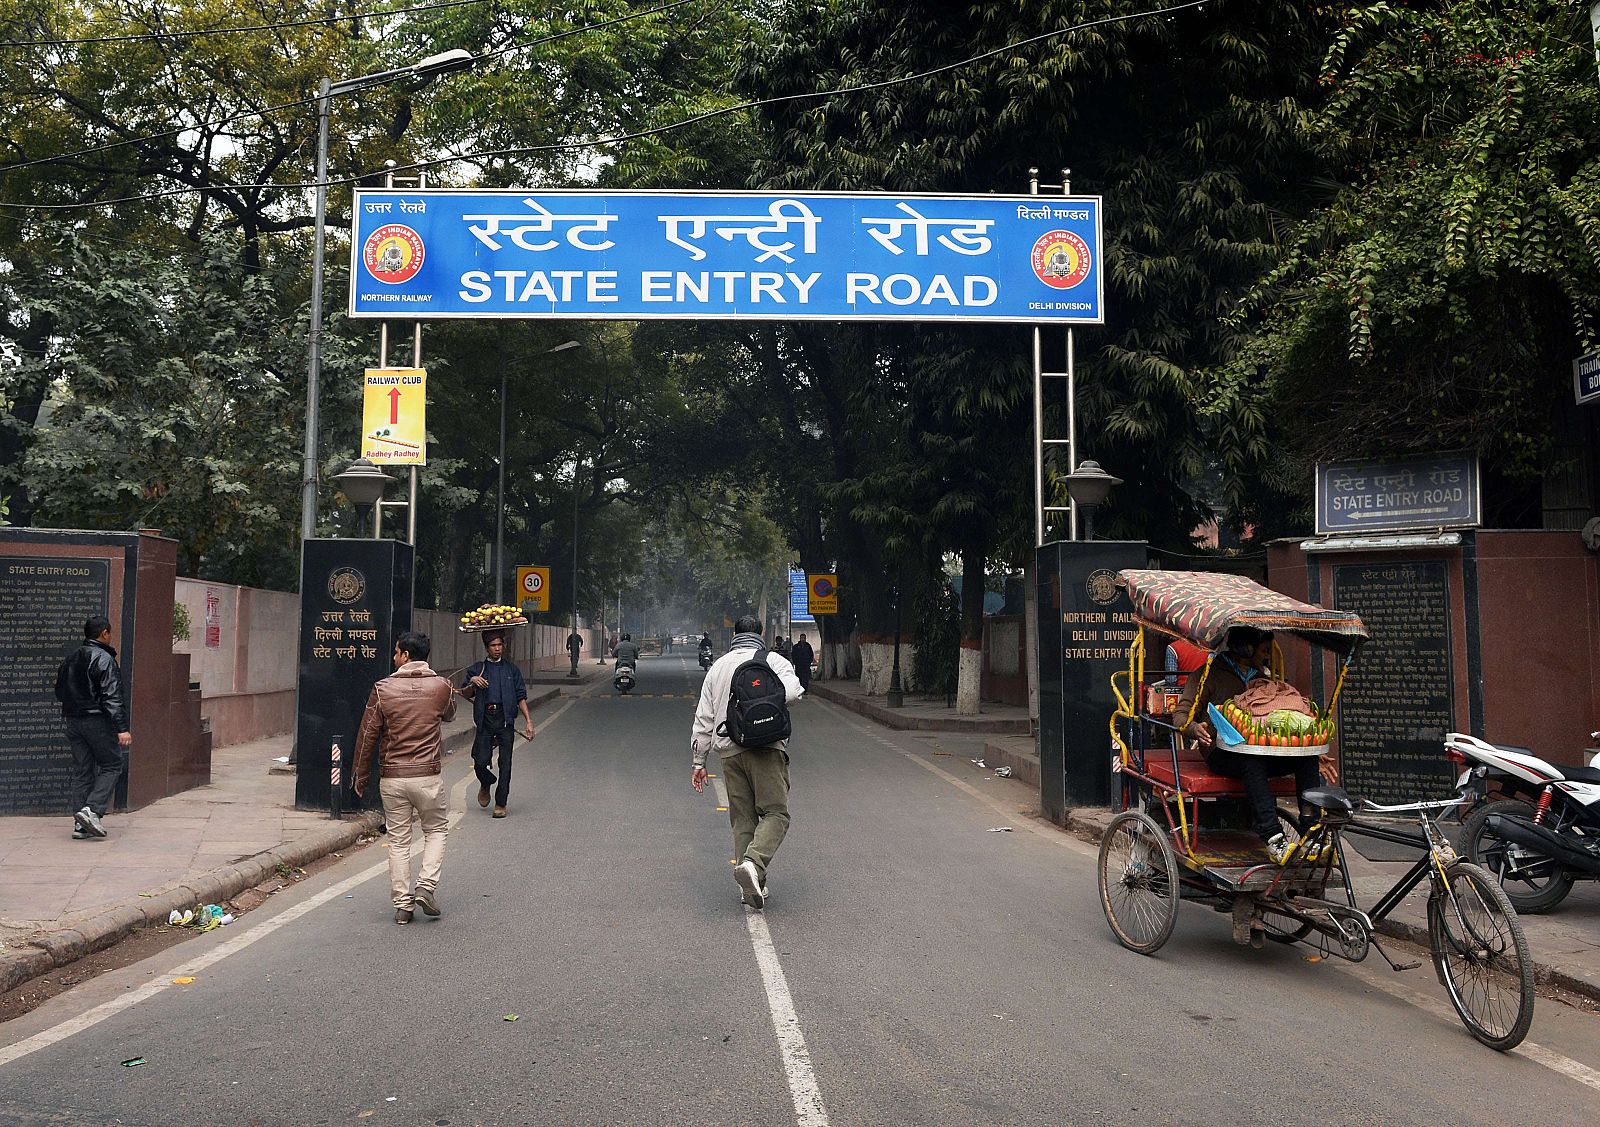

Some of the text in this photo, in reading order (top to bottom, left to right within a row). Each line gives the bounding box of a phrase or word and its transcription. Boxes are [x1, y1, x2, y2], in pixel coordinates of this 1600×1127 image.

[365, 199, 426, 213] उत्तर रेलवे
[1017, 205, 1089, 220] दिल्ली मण्डल
[462, 198, 995, 264] स्टेट एन्ट्री रोड
[388, 227, 422, 270] INDIAN RAILWAYS
[1054, 232, 1088, 276] INDIAN RAILWAYS
[458, 270, 998, 307] STATE ENTRY ROAD
[367, 376, 400, 384] RAILWAY
[1589, 374, 1600, 390] BO
[394, 450, 419, 458] Radhey
[1332, 474, 1367, 492] स्टेट
[1427, 466, 1461, 485] रोड
[1333, 488, 1462, 510] STATE ENTRY ROAD
[9, 566, 90, 576] STATE ENTRY ROAD
[527, 578, 539, 587] 30
[322, 609, 371, 622] उत्तर रेलवे
[1064, 613, 1106, 623] NORTHERN
[314, 627, 377, 642] दिल्ली मण्डल
[1072, 631, 1097, 641] DELHI
[313, 644, 331, 658] स्टेट
[361, 645, 377, 658] रोड
[1065, 648, 1094, 658] STATE
[1094, 648, 1122, 658] ENTRY
